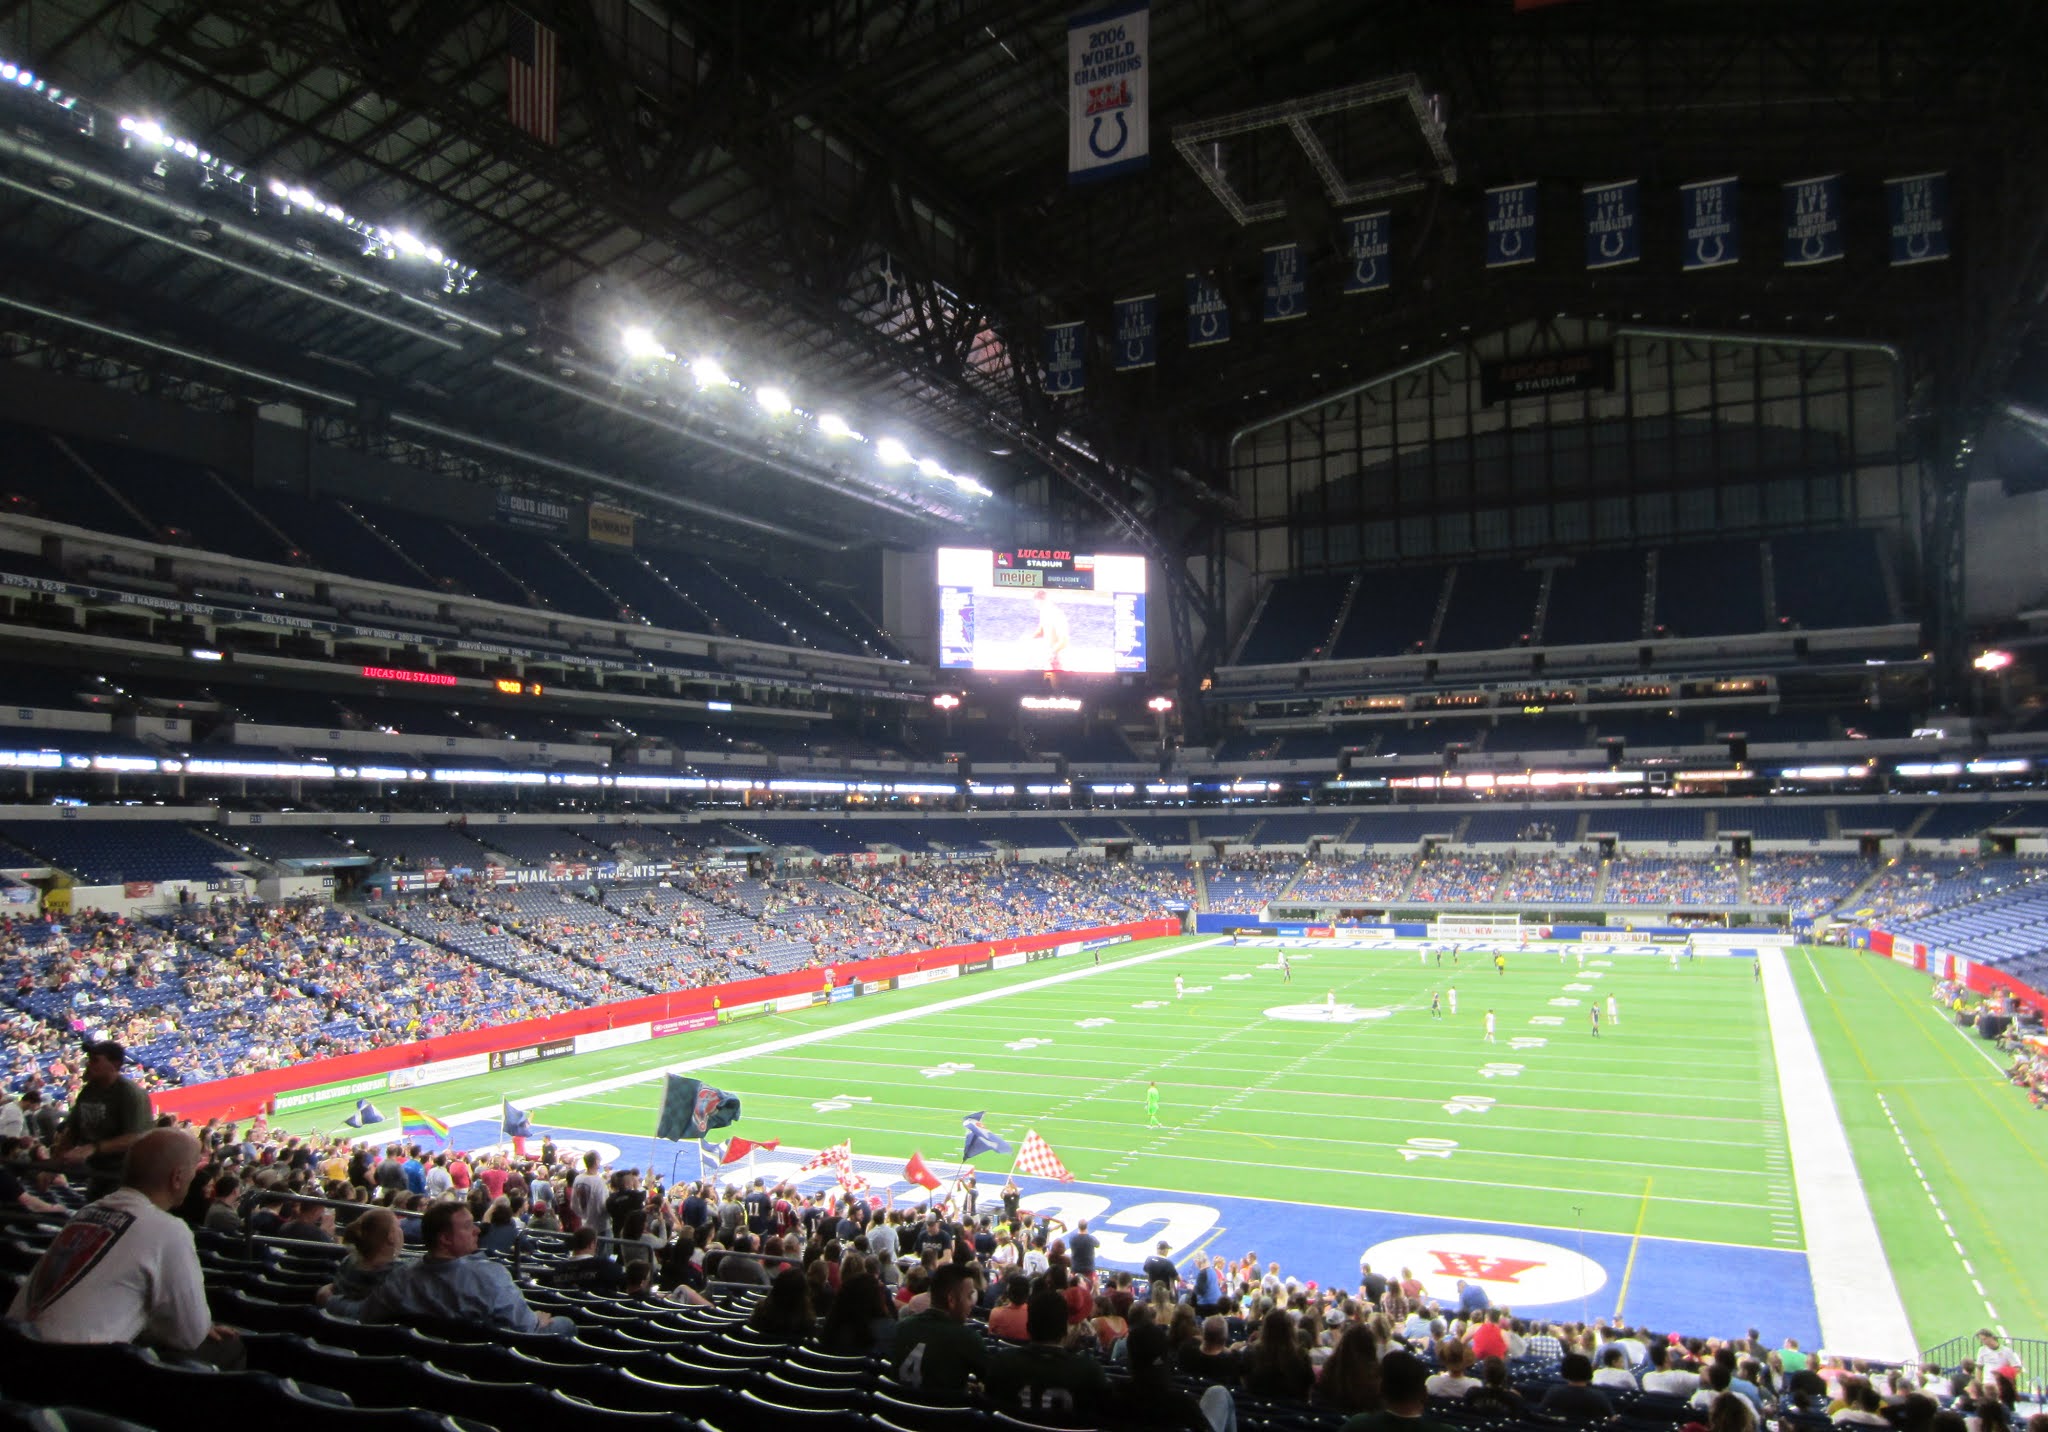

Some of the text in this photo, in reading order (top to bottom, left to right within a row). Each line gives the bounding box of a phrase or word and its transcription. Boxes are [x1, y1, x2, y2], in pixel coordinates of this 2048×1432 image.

[1089, 25, 1126, 48] 2006
[1081, 41, 1135, 67] WORLD
[1074, 54, 1141, 85] CHAMPIONS
[1488, 215, 1535, 232] WILDCARD
[1514, 376, 1576, 392] STADIUM
[510, 496, 569, 519] COLTS LOYALTY
[1017, 549, 1071, 561] LUCAS OIL
[1026, 560, 1063, 568] STADIUM
[1000, 570, 1037, 586] meijer
[120, 593, 135, 603] JIM
[137, 597, 180, 610] HARBAUGH
[262, 614, 313, 628] COLTS NATION
[355, 627, 372, 637] TONY
[373, 630, 396, 640] DUNGY
[457, 640, 481, 650] MARVIN
[481, 644, 509, 655] HARRISON
[364, 666, 457, 685] LUCAS OIL STADIUM
[597, 865, 656, 880] MMNTS
[505, 1052, 519, 1061] NOW
[276, 1077, 388, 1109] PEOPLE'S BREWING COMPANY
[812, 1094, 873, 1113] 10
[1396, 1137, 1459, 1160] 10
[748, 1201, 760, 1217] 11
[898, 1341, 927, 1390] 4
